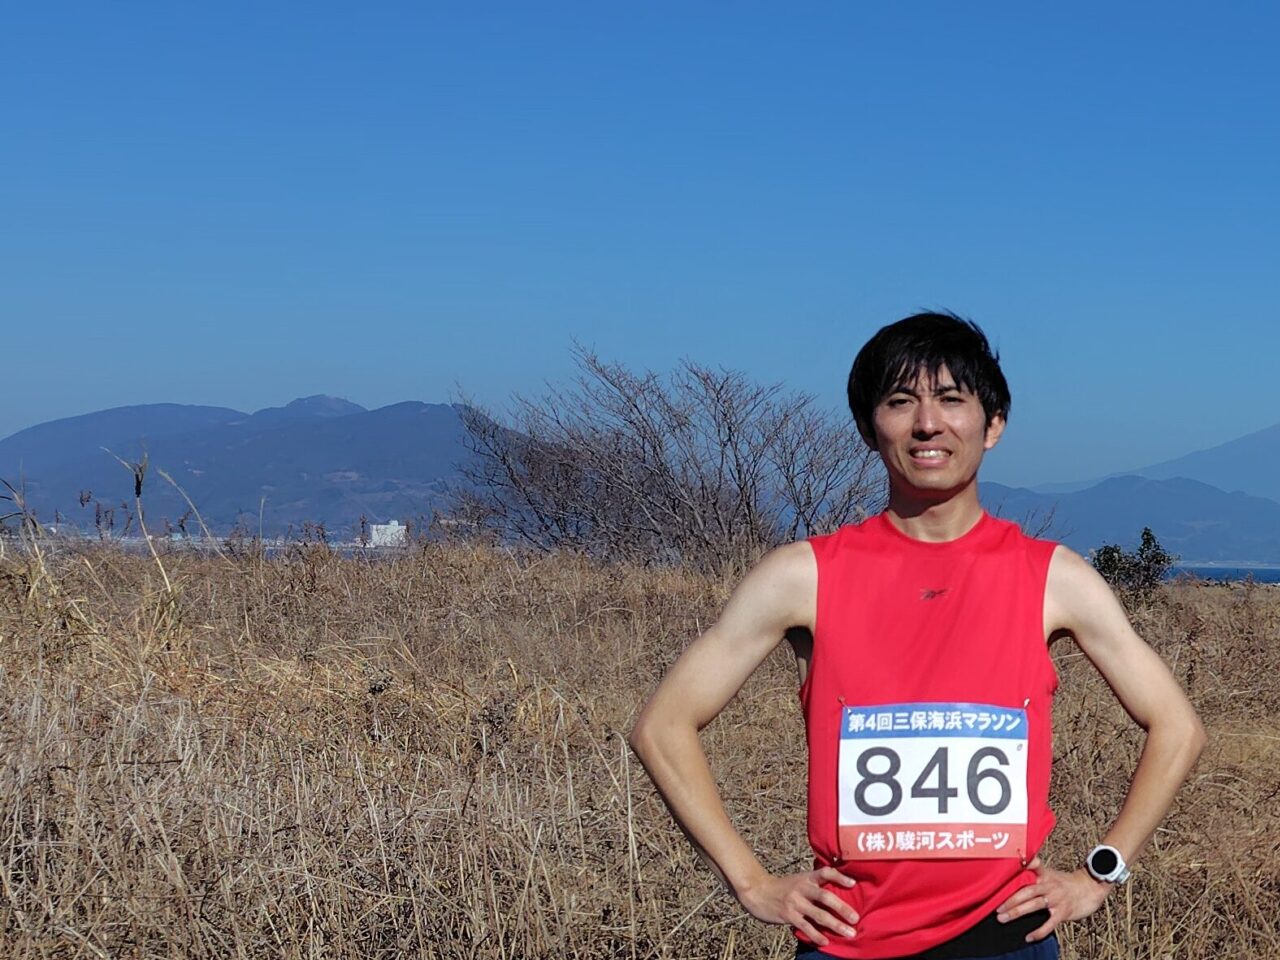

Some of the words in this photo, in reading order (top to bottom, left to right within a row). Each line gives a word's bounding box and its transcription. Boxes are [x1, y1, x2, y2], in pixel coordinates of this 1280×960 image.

[848, 710, 1021, 732] 第4回三保海浜マラソン
[853, 745, 1012, 817] 846
